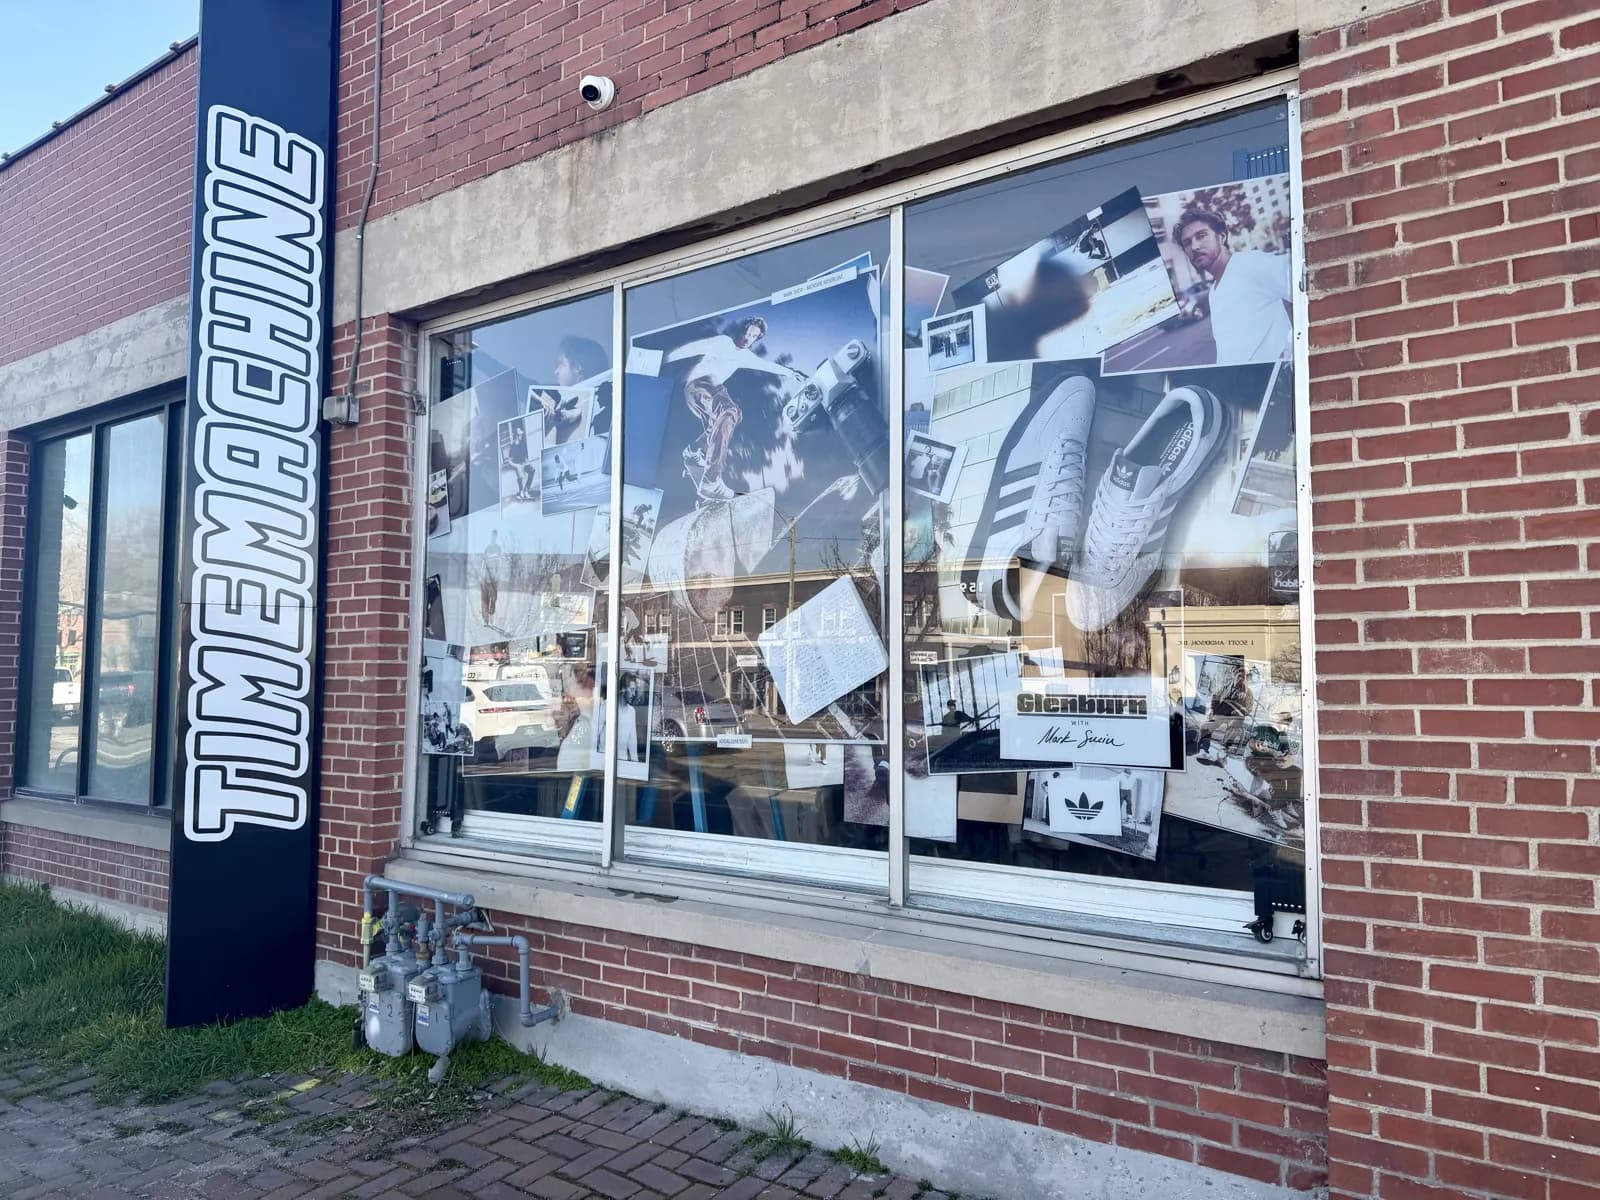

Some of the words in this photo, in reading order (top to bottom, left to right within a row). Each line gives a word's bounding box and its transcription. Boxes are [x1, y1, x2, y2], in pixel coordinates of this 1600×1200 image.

[184, 104, 325, 842] TIMEMACHINE
[1016, 693, 1147, 715] Glenburn
[1038, 726, 1077, 745] Mark
[387, 1004, 393, 1018] 2
